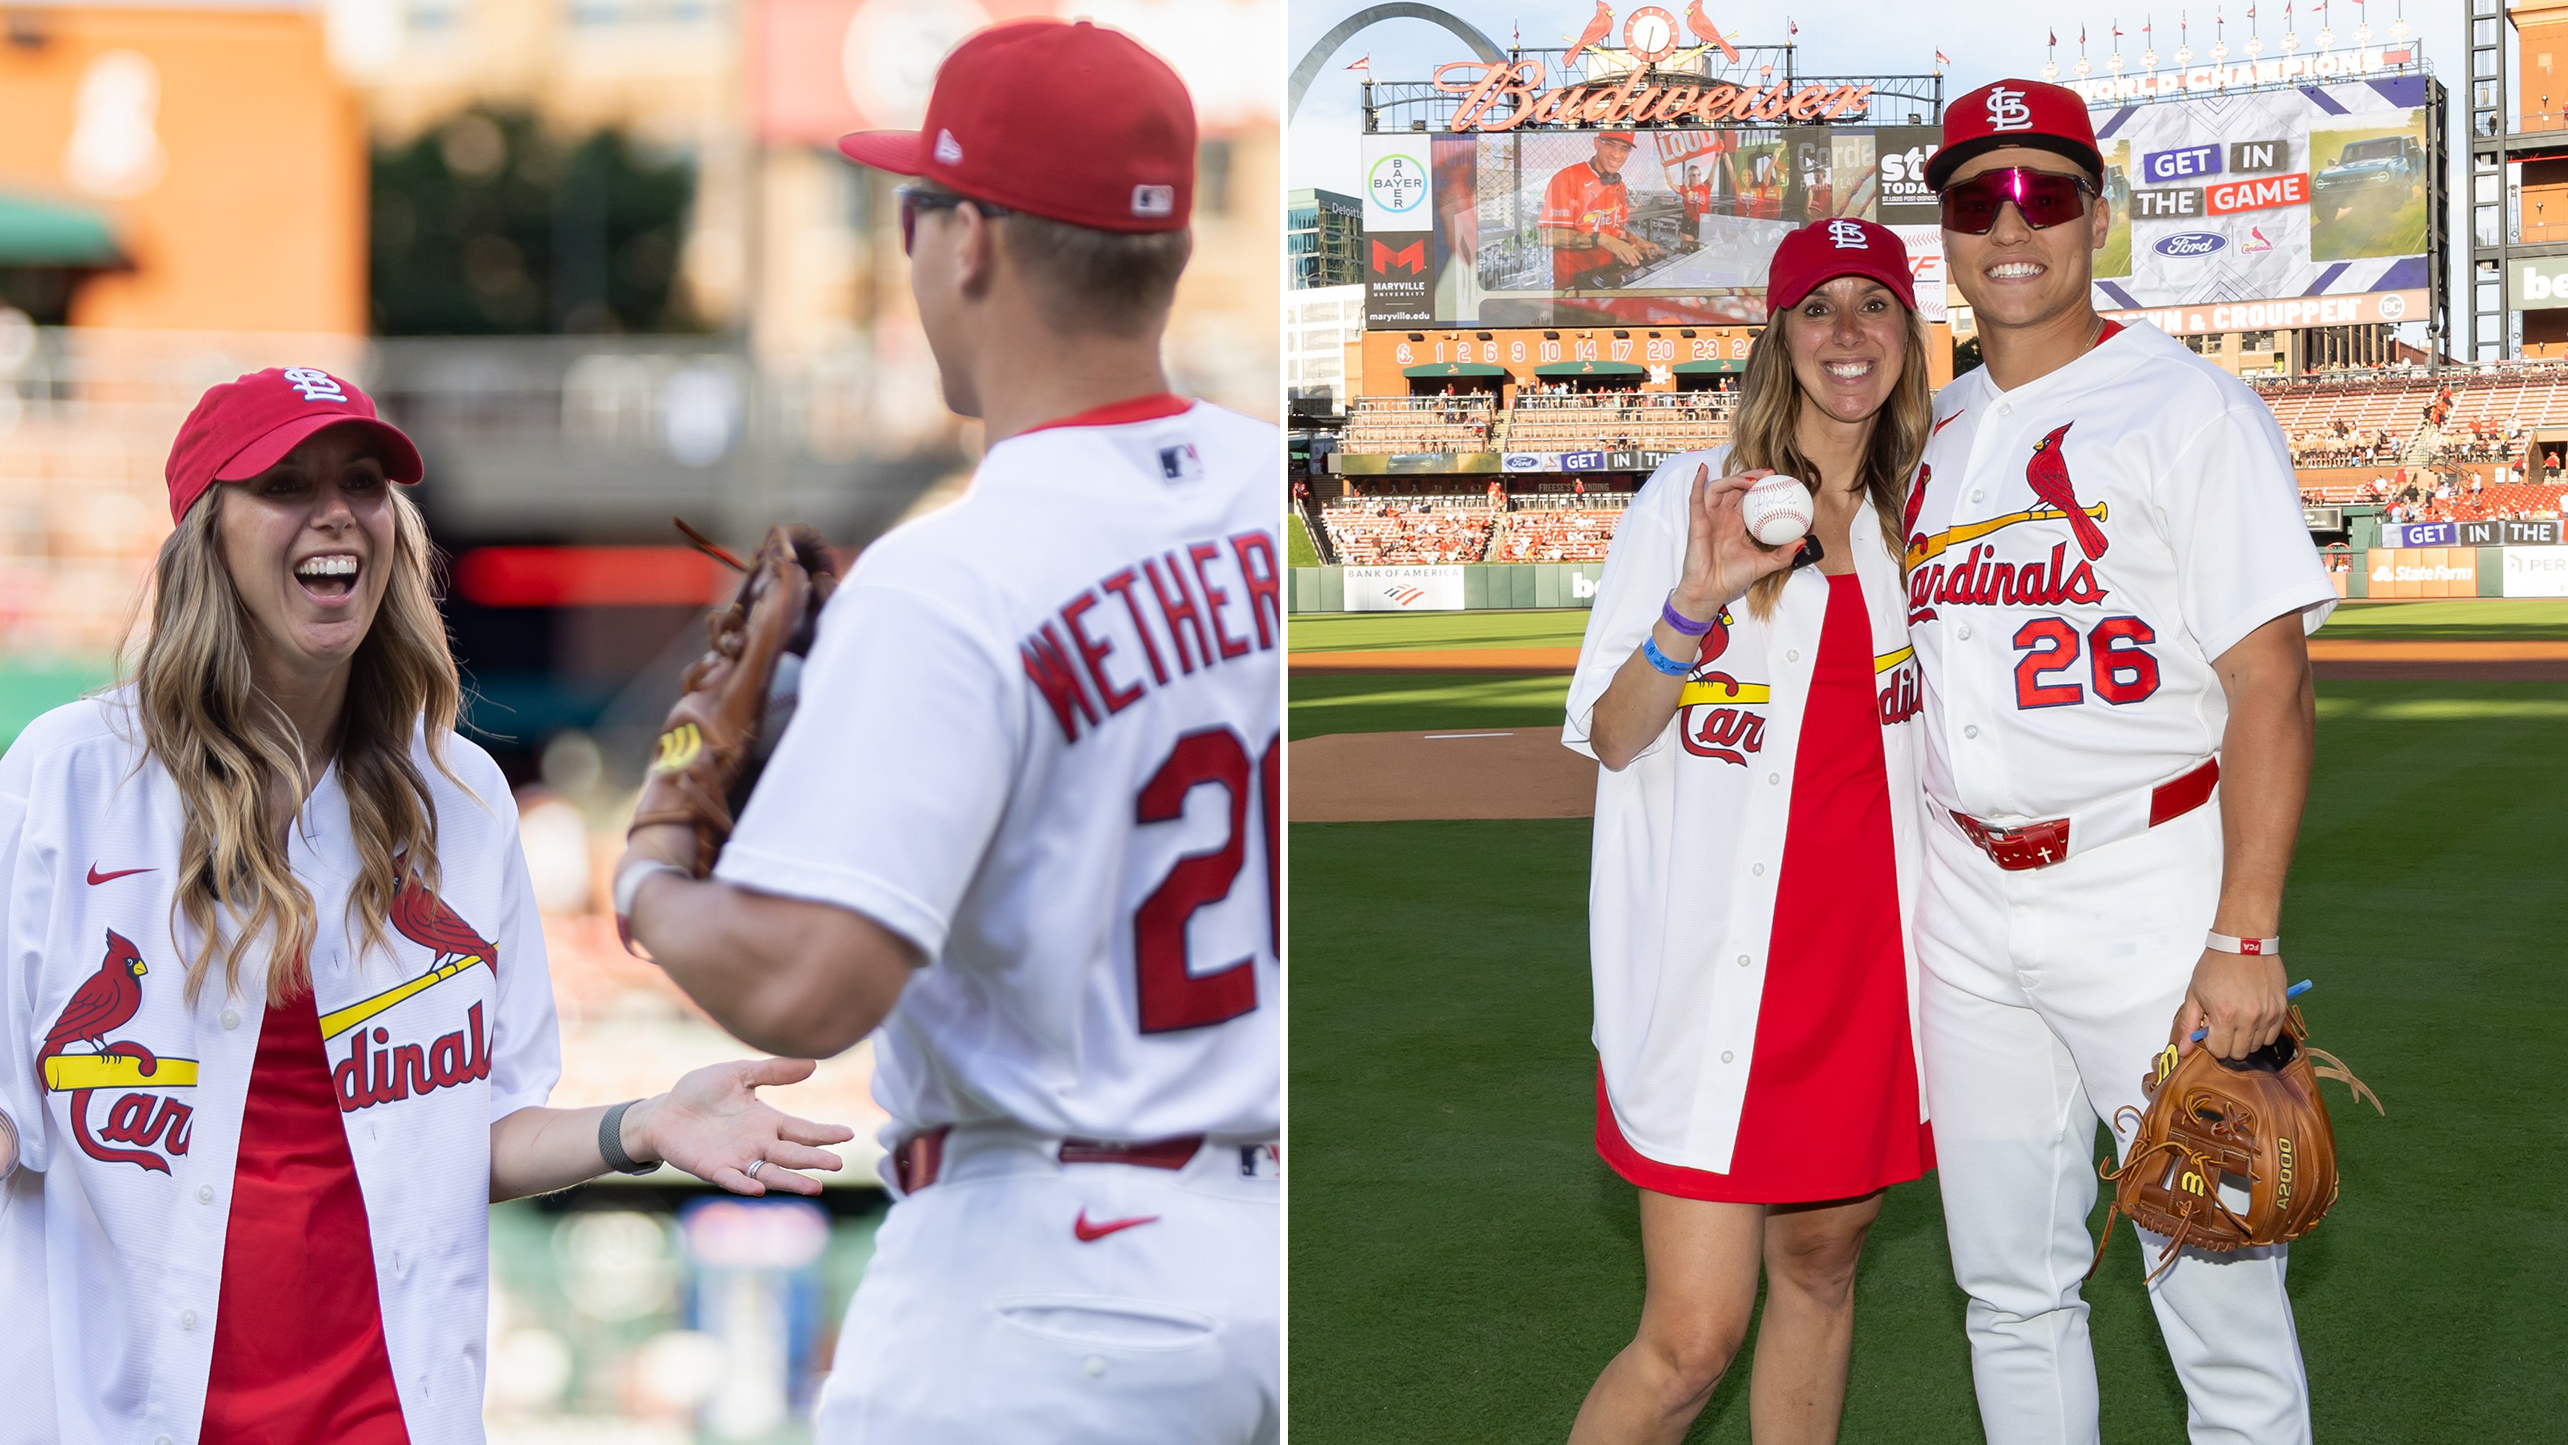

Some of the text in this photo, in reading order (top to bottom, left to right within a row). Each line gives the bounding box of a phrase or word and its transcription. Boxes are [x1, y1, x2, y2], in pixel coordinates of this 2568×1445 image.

[2070, 50, 2385, 103] WORLD CHAMPIONS
[1433, 60, 1873, 132] Budweiser
[1658, 131, 1716, 161] LOUD
[1735, 130, 1783, 148] TIME
[2154, 144, 2274, 178] GET IN
[1374, 179, 1422, 188] BAYER
[1393, 160, 1403, 208] BAYER
[1881, 182, 1936, 195] TODA
[2137, 177, 2301, 215] THE GAME
[2167, 235, 2214, 254] Ford
[1373, 282, 1425, 291] MARYVILLE
[1369, 311, 1430, 322] maryville.edu
[2189, 313, 2206, 331] &
[2212, 299, 2357, 330] CROUPPEN
[1435, 342, 1444, 364] 1
[1457, 342, 1471, 364] 2
[1484, 341, 1498, 363] 6
[1511, 341, 1526, 362] 9
[1539, 341, 1561, 361] 10
[1575, 340, 1597, 361] 14
[1611, 340, 1633, 361] 17
[1647, 339, 1675, 361] 20
[1692, 339, 1719, 360] 23
[1512, 459, 1534, 467] Ford
[1566, 453, 1598, 469] GET
[1613, 454, 1630, 467] IN
[1538, 483, 1610, 492] FREESE'S ANDING
[2409, 523, 2551, 543] GET IN THE
[1403, 569, 1459, 577] AMERICA
[2012, 615, 2161, 710] 26
[2276, 1137, 2293, 1211] A2000
